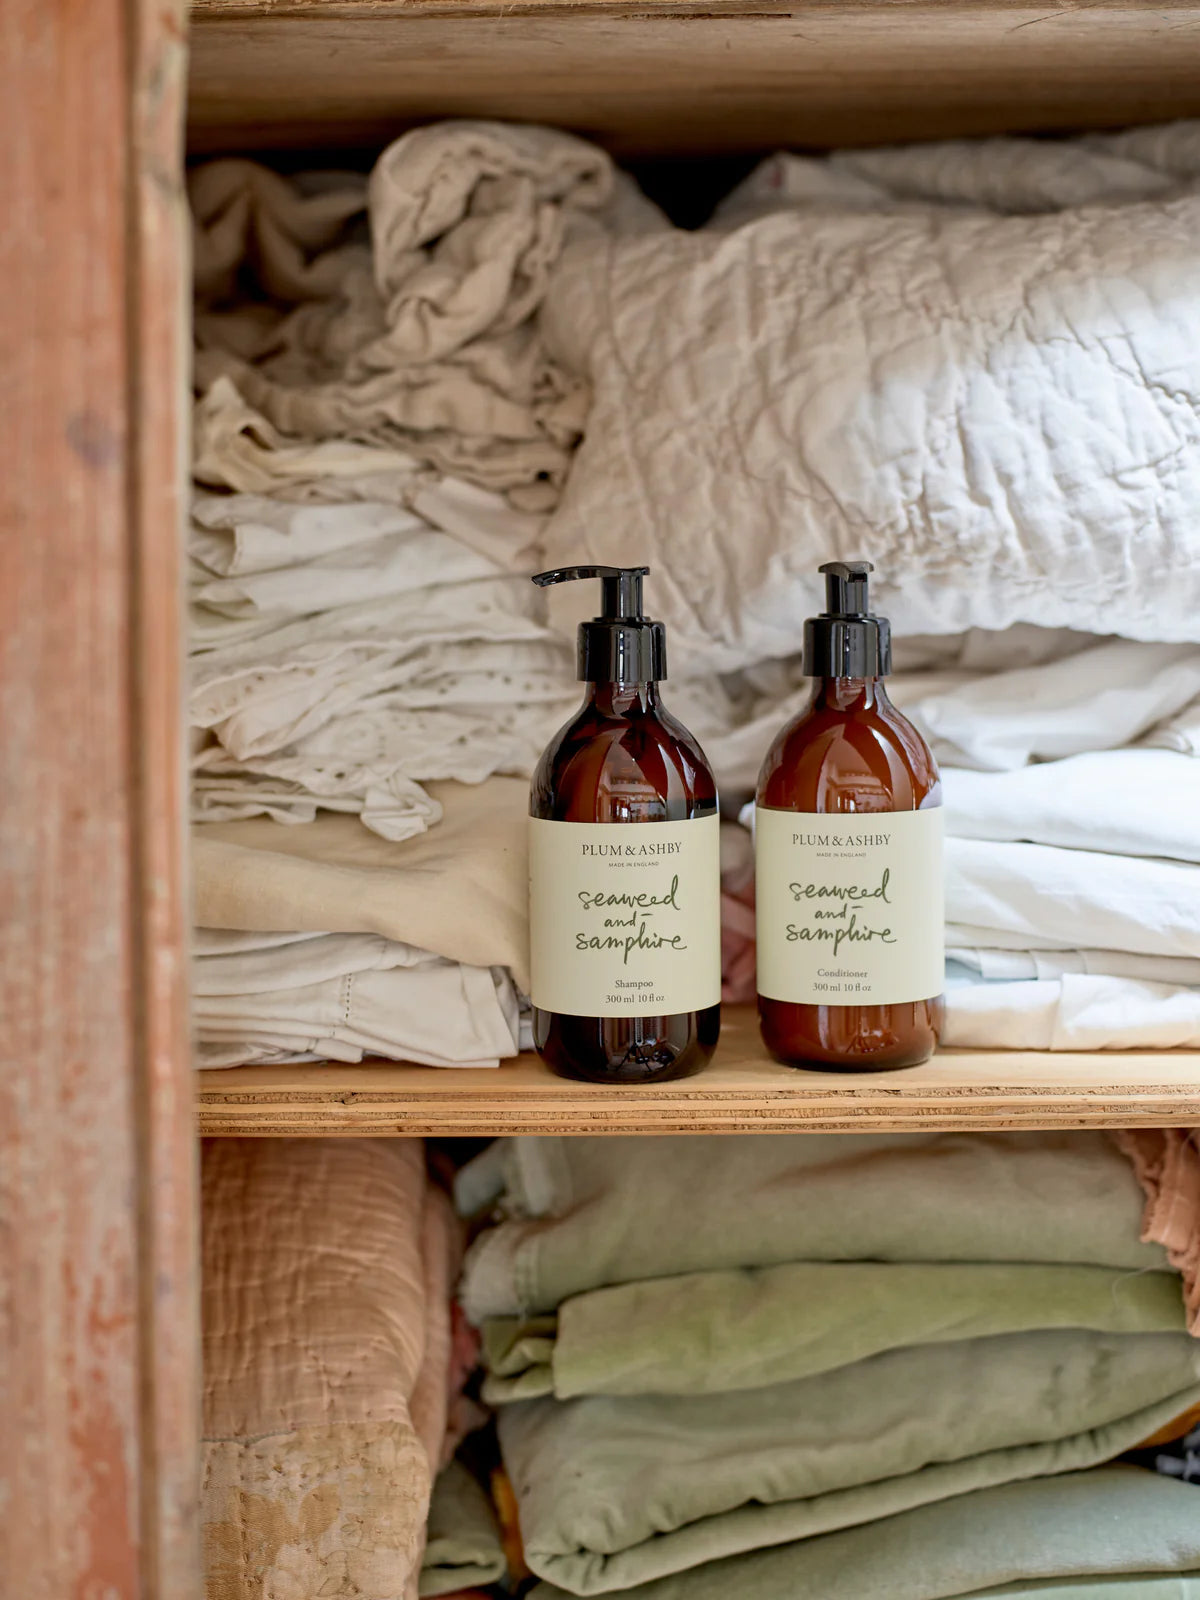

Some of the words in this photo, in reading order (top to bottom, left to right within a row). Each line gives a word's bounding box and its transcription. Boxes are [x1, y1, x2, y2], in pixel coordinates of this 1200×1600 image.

[577, 874, 681, 911] seaweed
[788, 867, 892, 904] seaweed
[575, 921, 688, 966] samphire
[785, 914, 897, 957] samphire
[614, 979, 654, 990] Shampoo
[817, 968, 868, 979] Conditioner
[605, 994, 622, 1004] 300
[623, 994, 635, 1004] ml
[638, 994, 648, 1003] 10
[649, 993, 655, 1003] fl
[655, 994, 665, 1003] oz
[812, 982, 829, 992] 300
[829, 982, 841, 992] ml
[843, 983, 854, 992] 10
[854, 982, 861, 992] fl
[861, 984, 872, 992] oz
